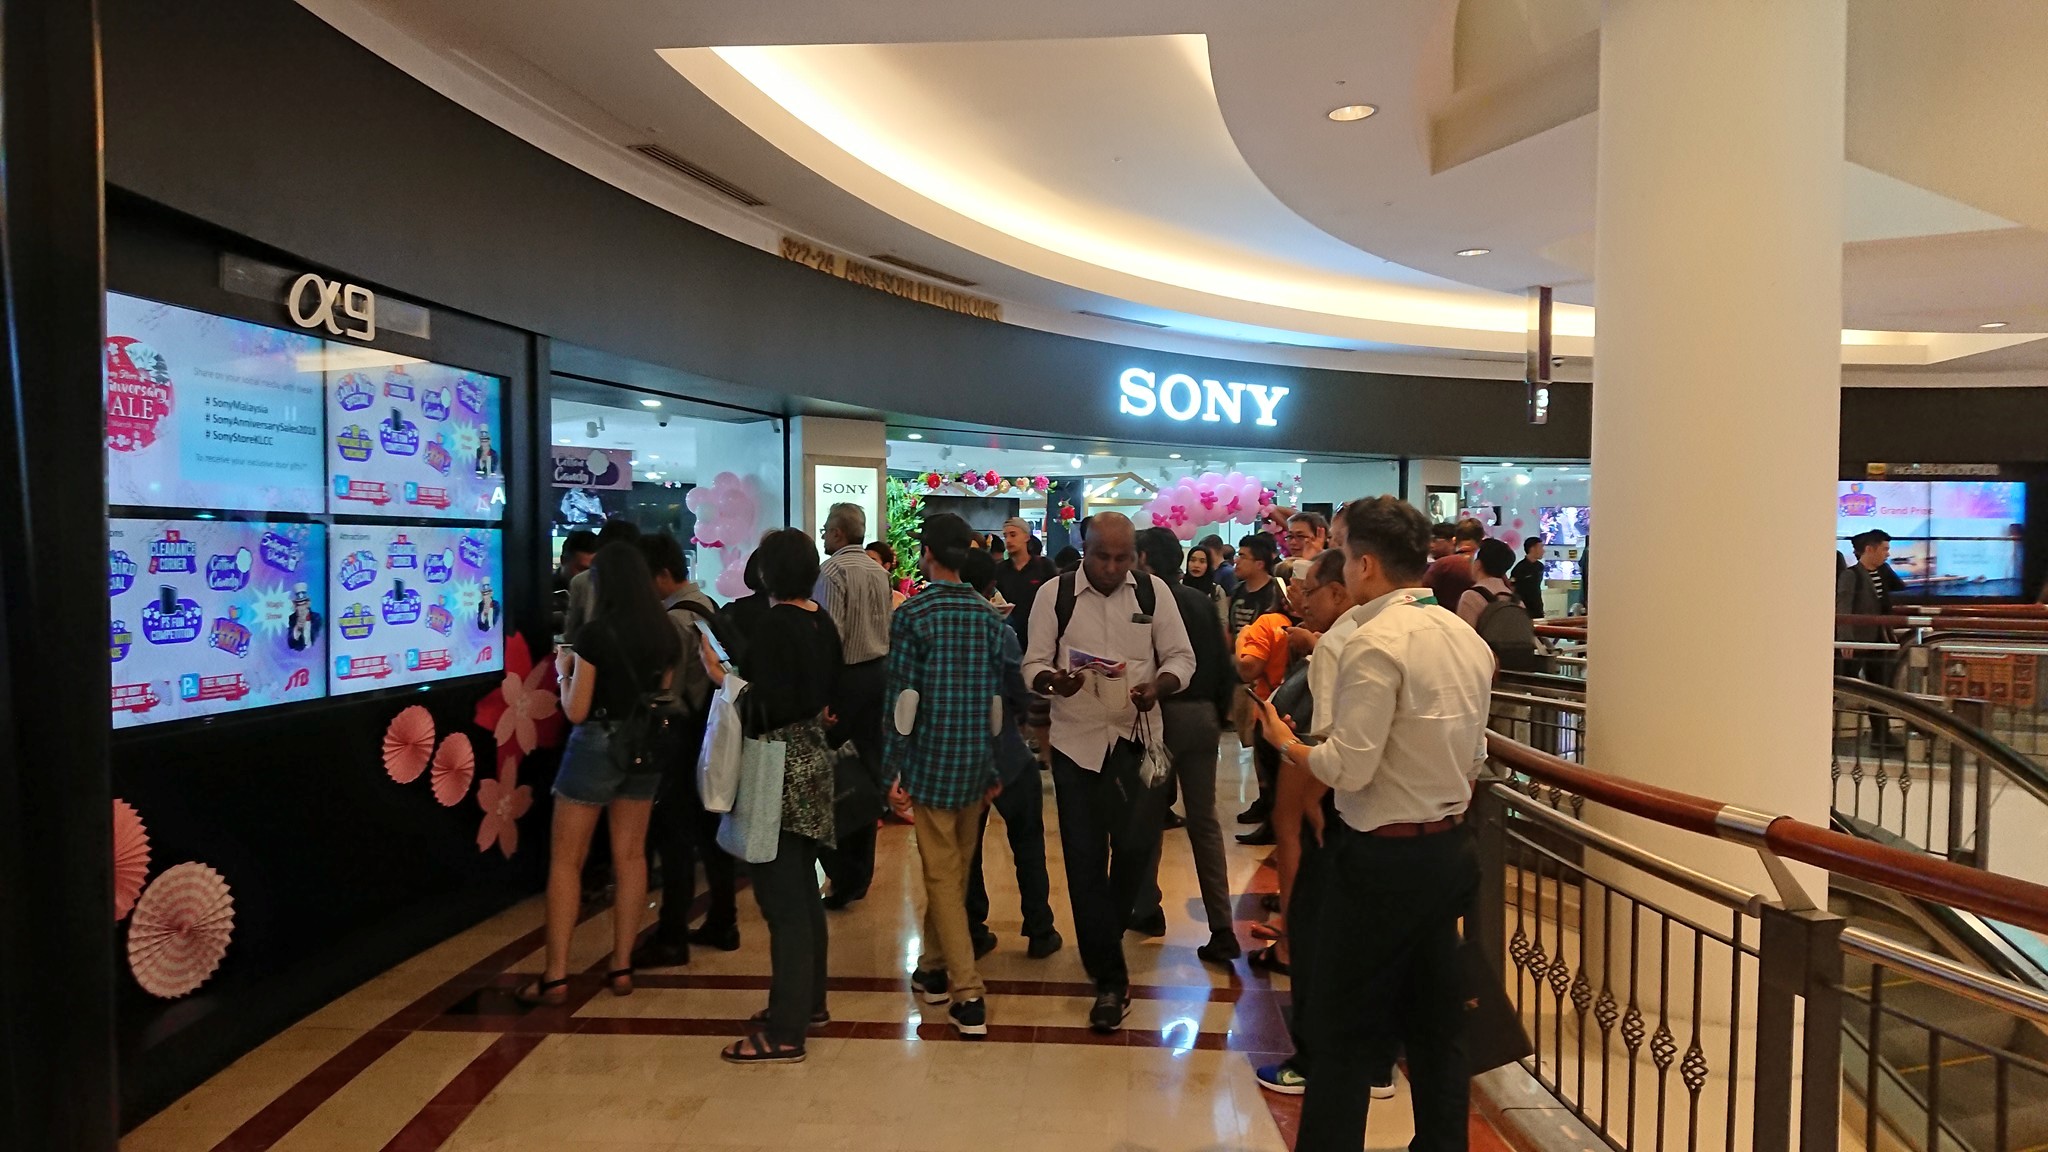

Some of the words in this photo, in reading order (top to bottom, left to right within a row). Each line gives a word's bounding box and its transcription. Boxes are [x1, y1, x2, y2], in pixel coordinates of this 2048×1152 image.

[1119, 367, 1290, 427] SONY
[109, 395, 154, 420] ALE
[212, 397, 269, 414] SonyMalaysia
[212, 430, 274, 446] SonyStoreKLCC
[554, 466, 589, 485] Candy
[822, 483, 868, 494] SONY
[1880, 506, 1908, 515] Grand
[149, 541, 196, 557] CLEARANCE
